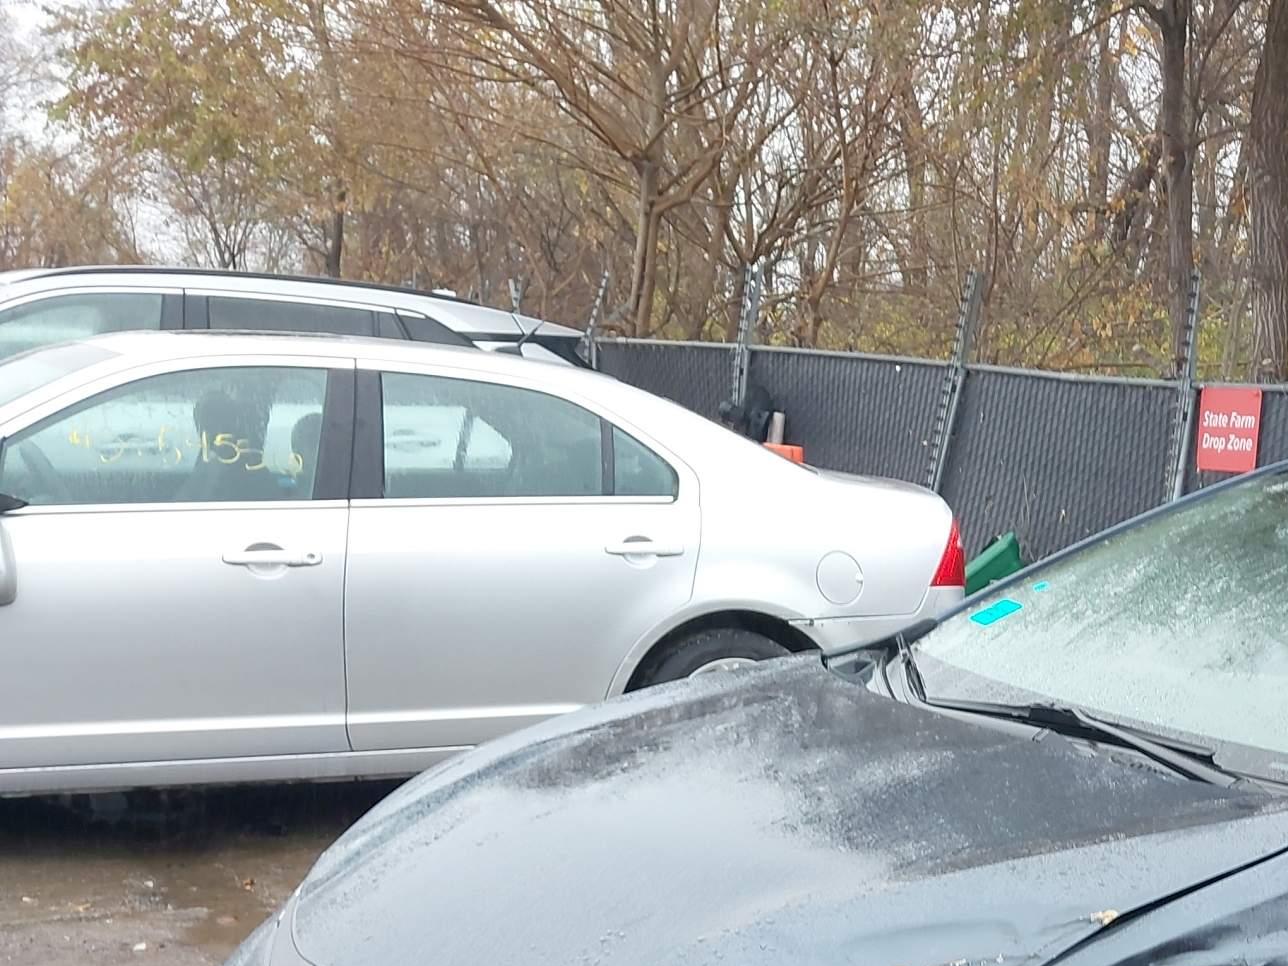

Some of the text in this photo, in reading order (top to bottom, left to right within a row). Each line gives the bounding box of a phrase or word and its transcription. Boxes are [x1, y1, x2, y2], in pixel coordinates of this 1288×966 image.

[1203, 411, 1255, 428] State Farm
[1202, 433, 1253, 453] Drop Zone
